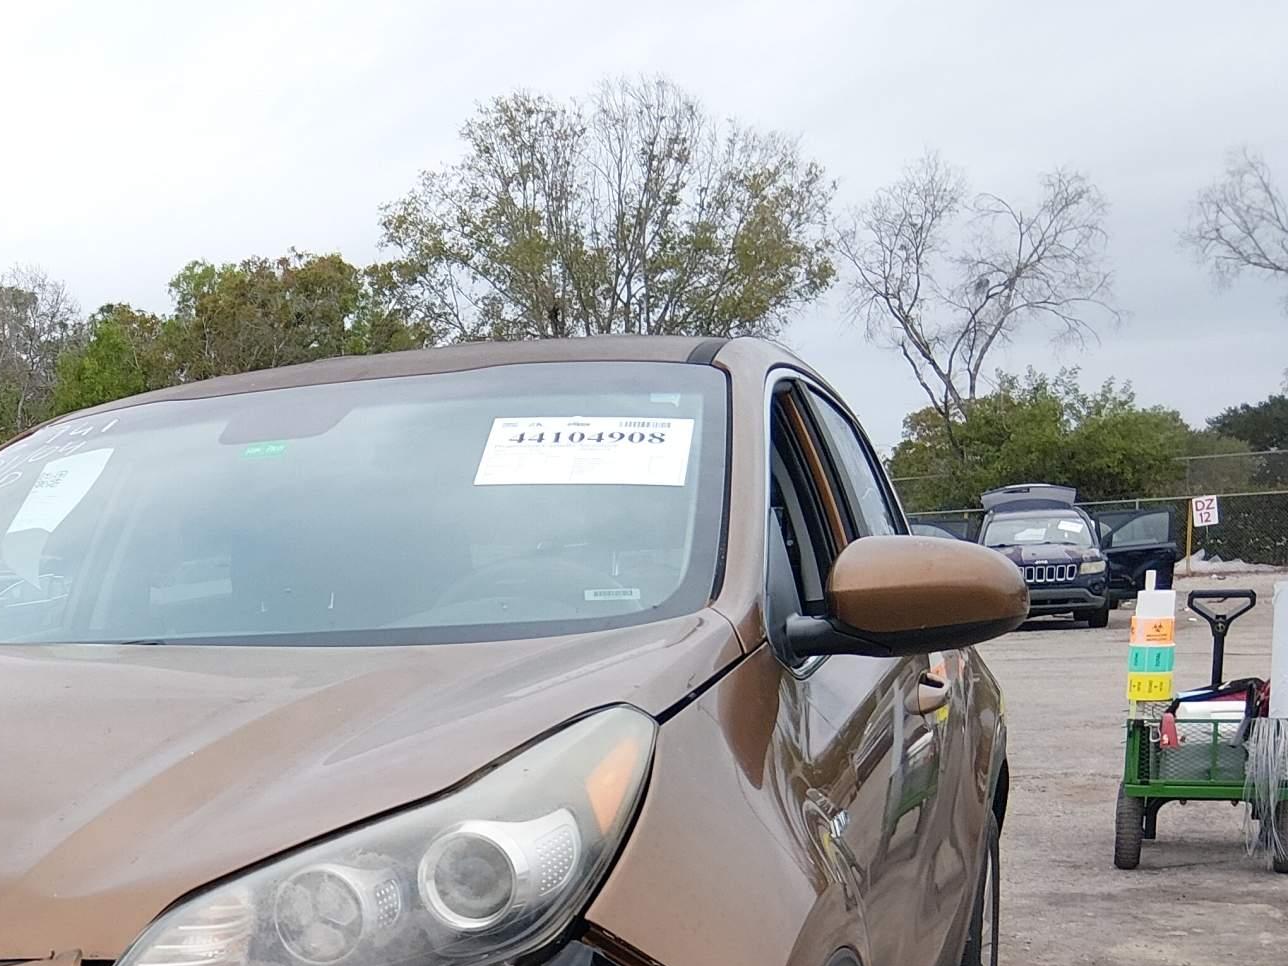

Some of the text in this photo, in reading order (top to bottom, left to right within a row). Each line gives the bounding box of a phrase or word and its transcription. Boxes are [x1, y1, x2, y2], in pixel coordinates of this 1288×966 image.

[508, 432, 666, 444] 44104908
[1195, 498, 1215, 511] DZ
[1199, 512, 1211, 523] 12
